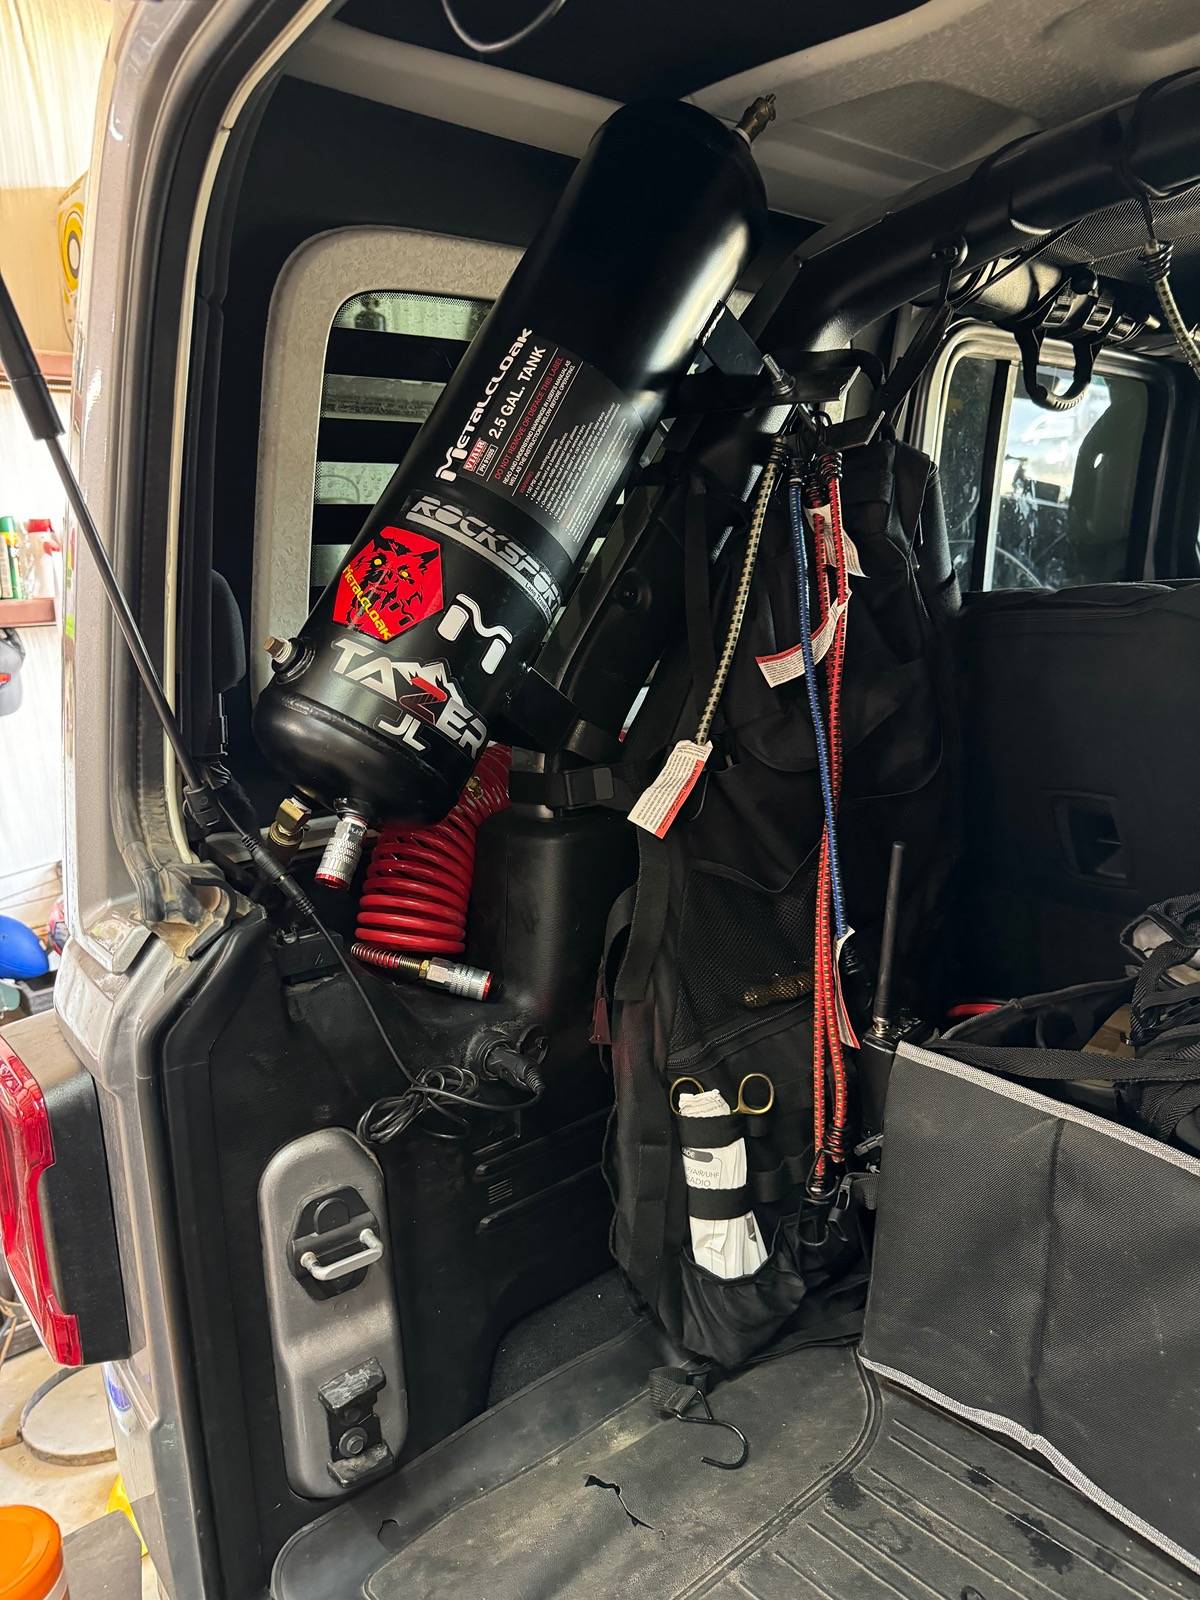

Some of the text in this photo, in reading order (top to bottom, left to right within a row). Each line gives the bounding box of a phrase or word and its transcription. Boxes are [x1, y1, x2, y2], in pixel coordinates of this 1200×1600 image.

[488, 343, 546, 439] 2.5 GAL. TANK
[494, 355, 563, 479] DO NOT REMOVE OR DEFACE THIS LABEL
[502, 470, 512, 484] READ
[509, 460, 518, 471] AND
[514, 430, 534, 461] UNDERSTAND
[530, 406, 546, 431] WARNINGS
[554, 366, 567, 386] MANUAL
[564, 359, 571, 367] AS
[508, 472, 518, 486] WELL
[514, 465, 522, 473] AS
[518, 456, 527, 466] THE
[523, 423, 544, 457] INSTRUCTIONS
[540, 407, 552, 424] BELOW
[548, 389, 561, 408] BEFORE
[334, 638, 488, 759] TAZER
[377, 713, 429, 752] JL
